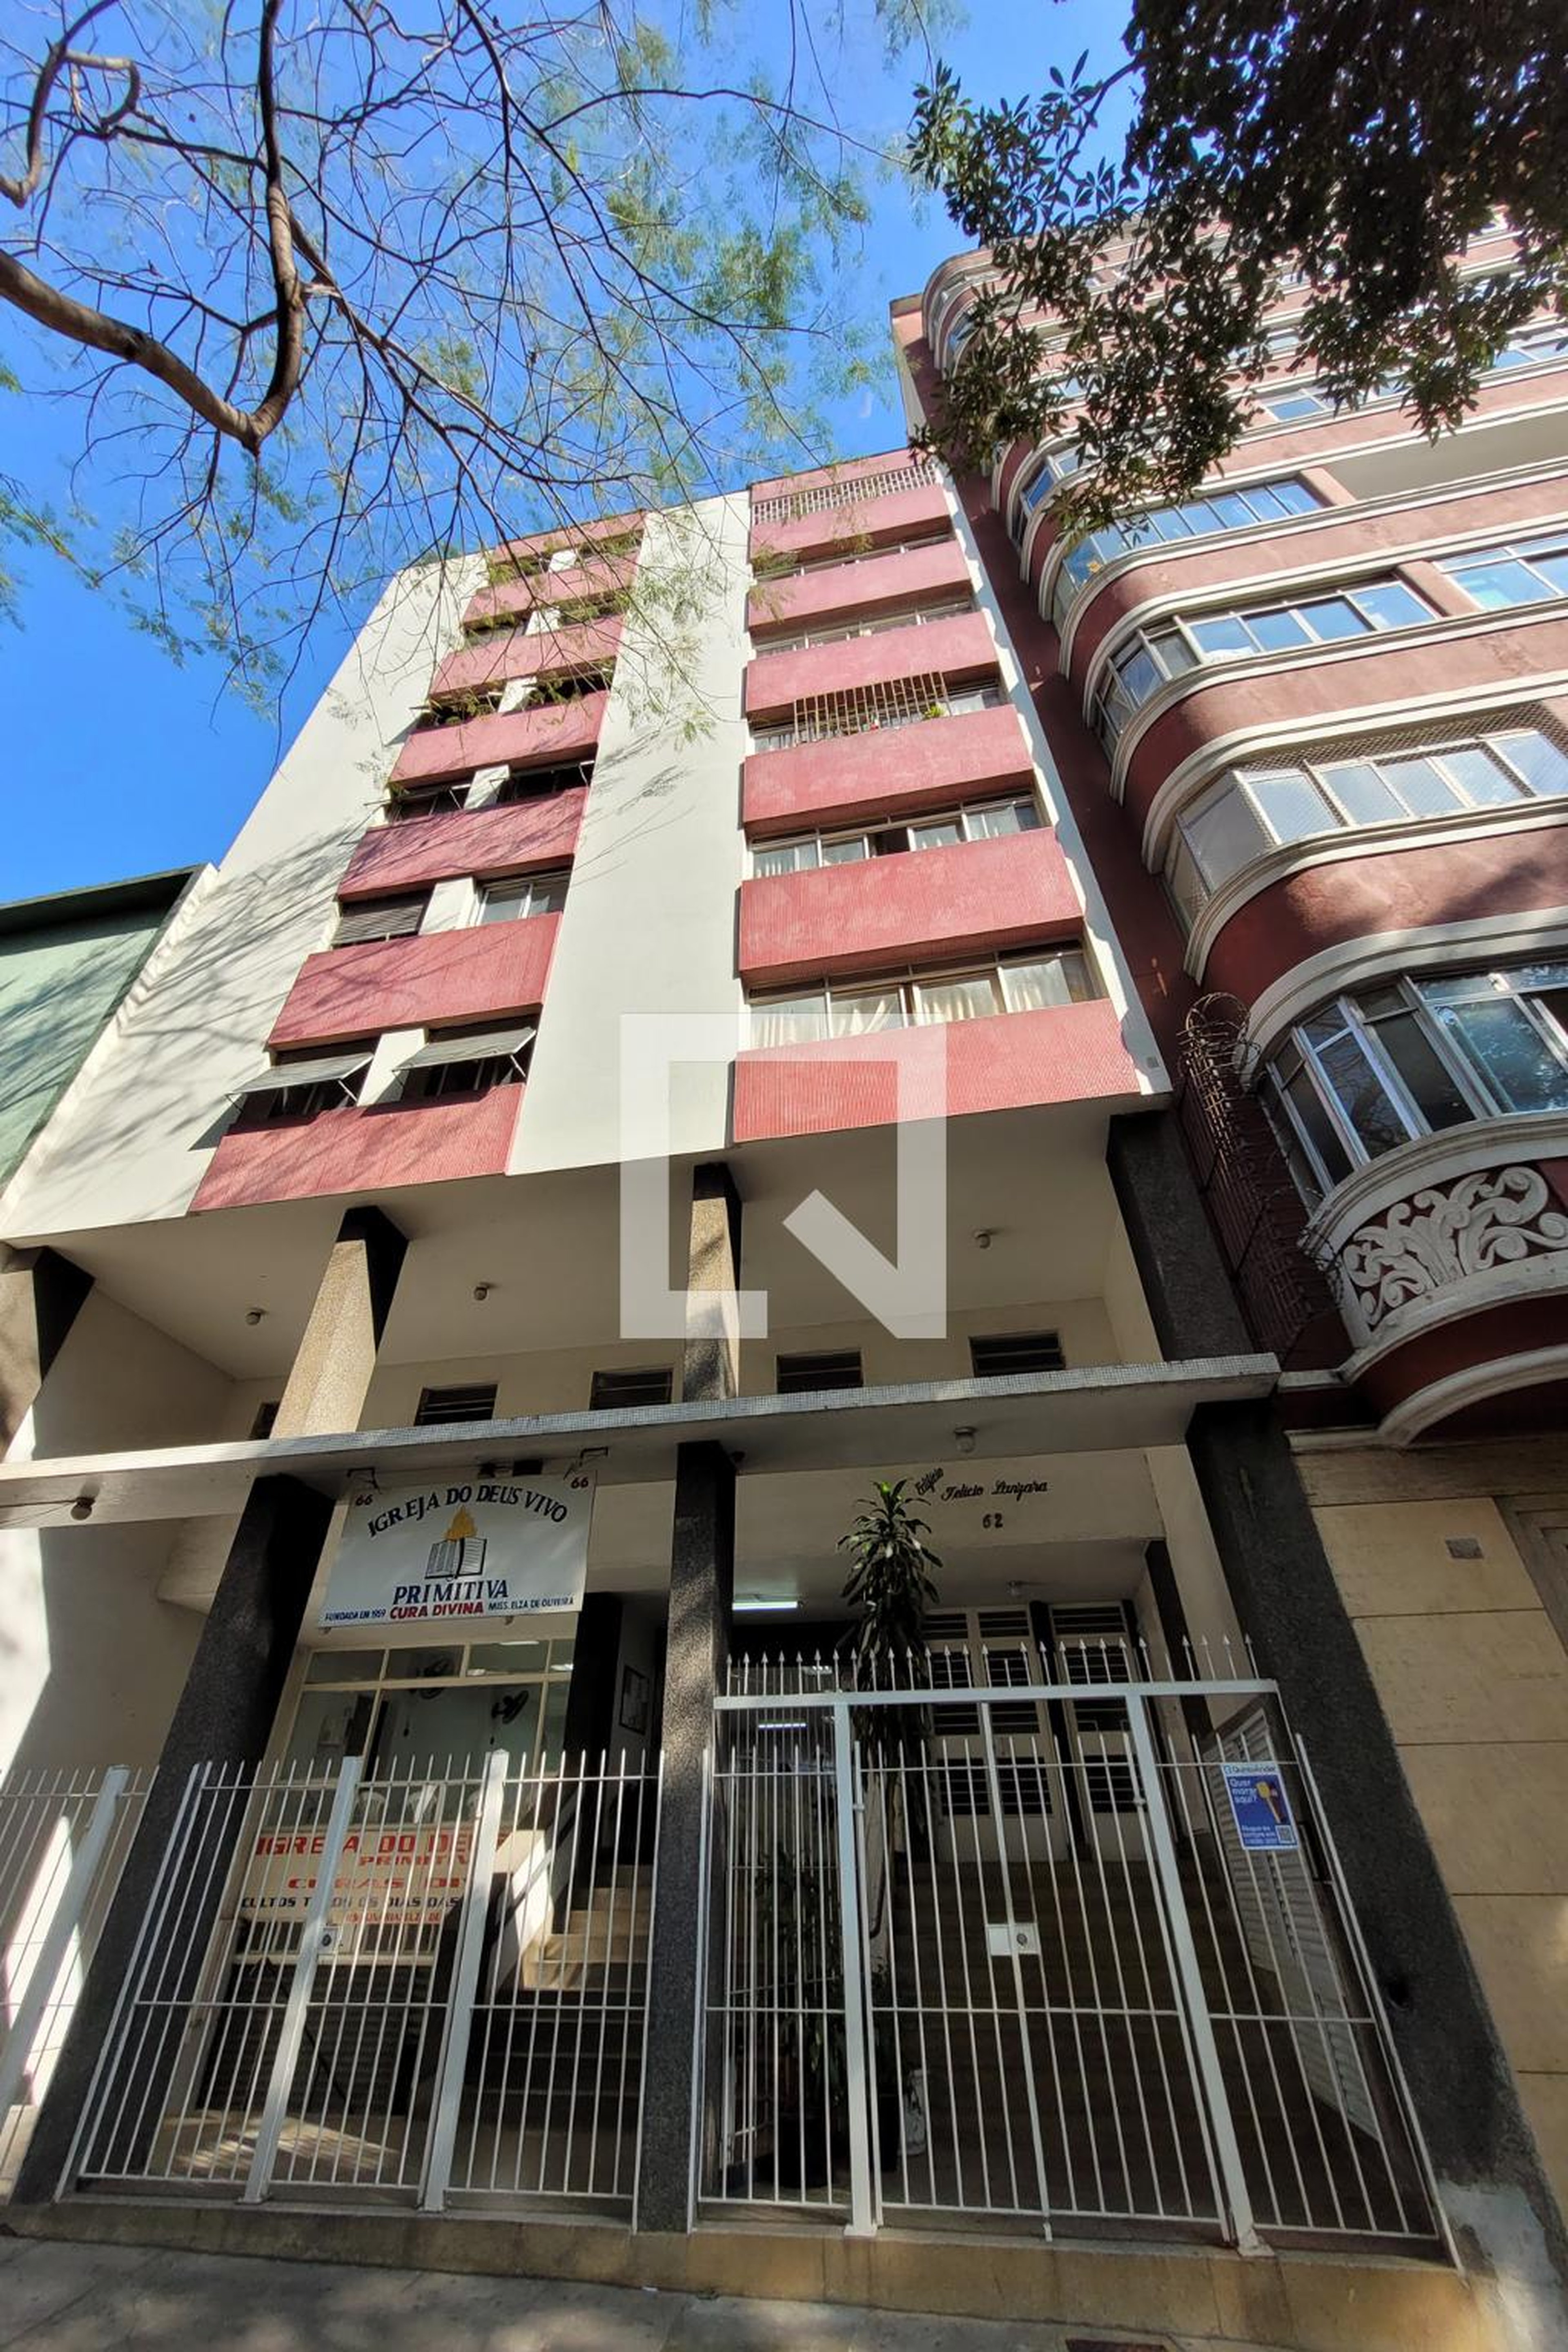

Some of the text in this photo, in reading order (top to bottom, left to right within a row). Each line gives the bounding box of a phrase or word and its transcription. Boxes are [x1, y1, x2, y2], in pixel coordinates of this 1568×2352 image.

[570, 1477, 589, 1489] 66
[355, 1494, 374, 1506] 66
[368, 1485, 567, 1537] IGREJA DO DEUS VIVO
[982, 1512, 1003, 1528] 62
[393, 1580, 509, 1605] PRIMITIVA
[390, 1601, 484, 1619] CURA DIVINA
[511, 1600, 528, 1609] ELZA
[531, 1599, 539, 1608] DE
[256, 1836, 361, 1855] IGREA
[378, 1836, 415, 1853] DO
